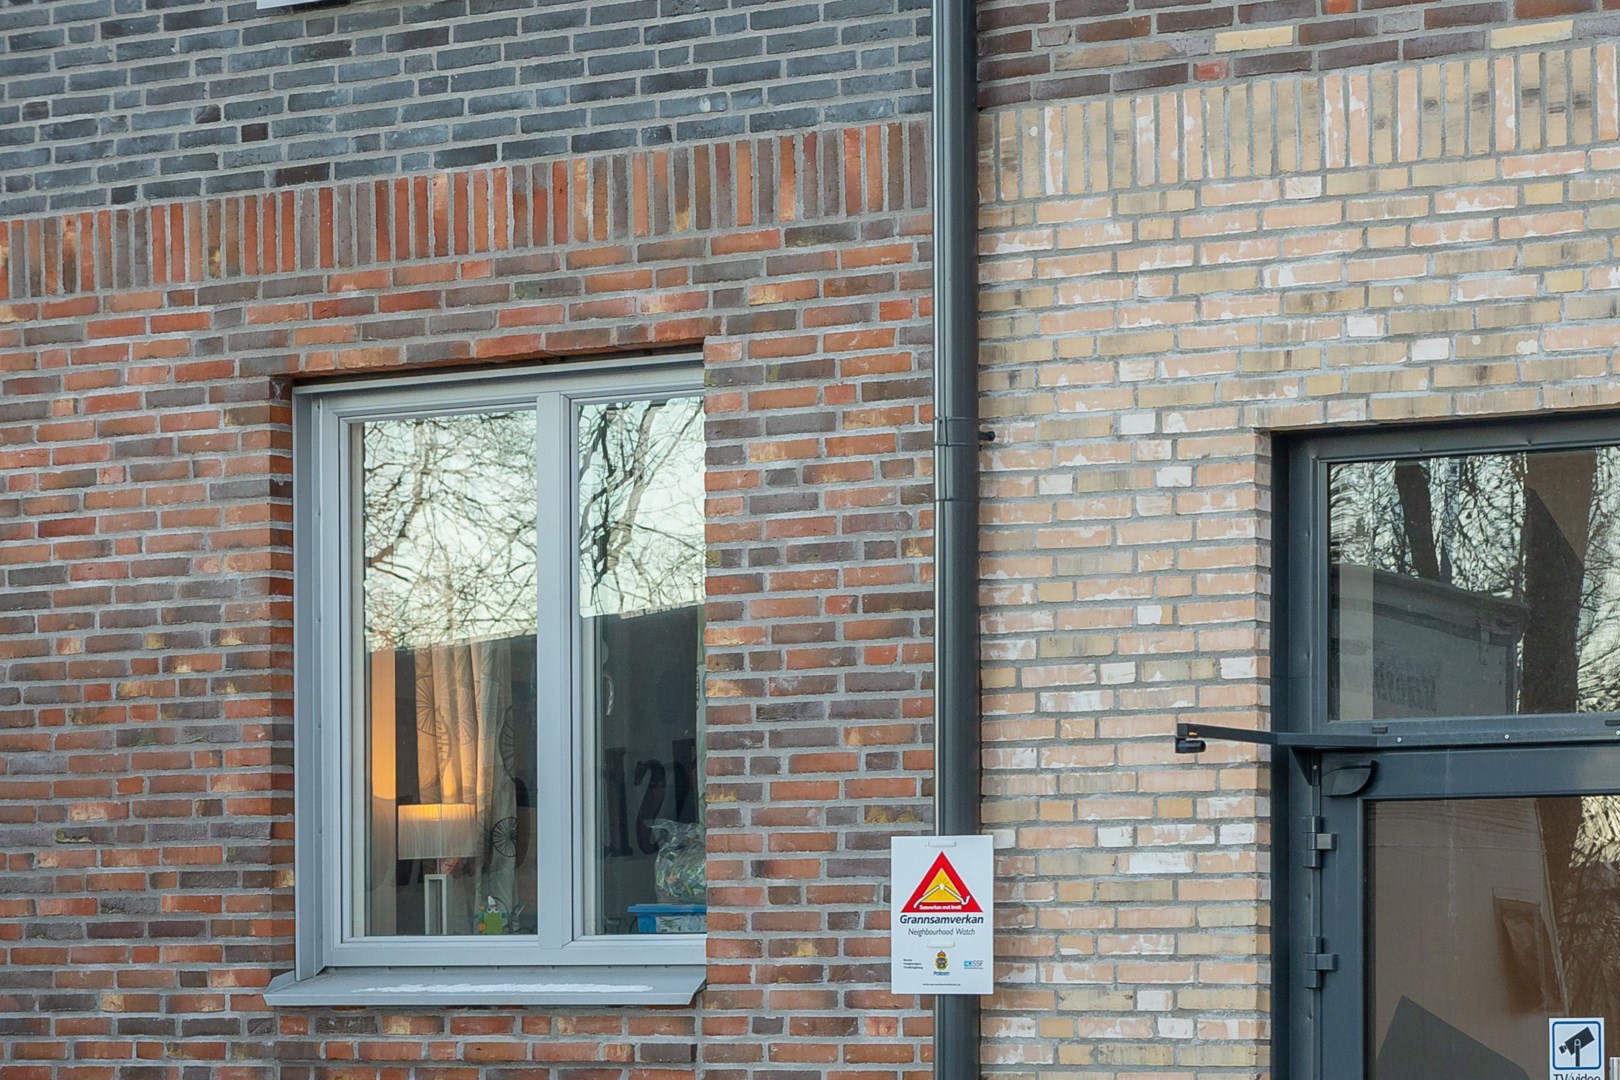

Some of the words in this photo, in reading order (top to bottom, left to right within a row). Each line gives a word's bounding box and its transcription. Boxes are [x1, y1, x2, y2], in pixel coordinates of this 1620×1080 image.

[900, 915, 984, 924] Grannsamverkan
[908, 928, 954, 937] Neighbourhood
[956, 928, 976, 936] Watch
